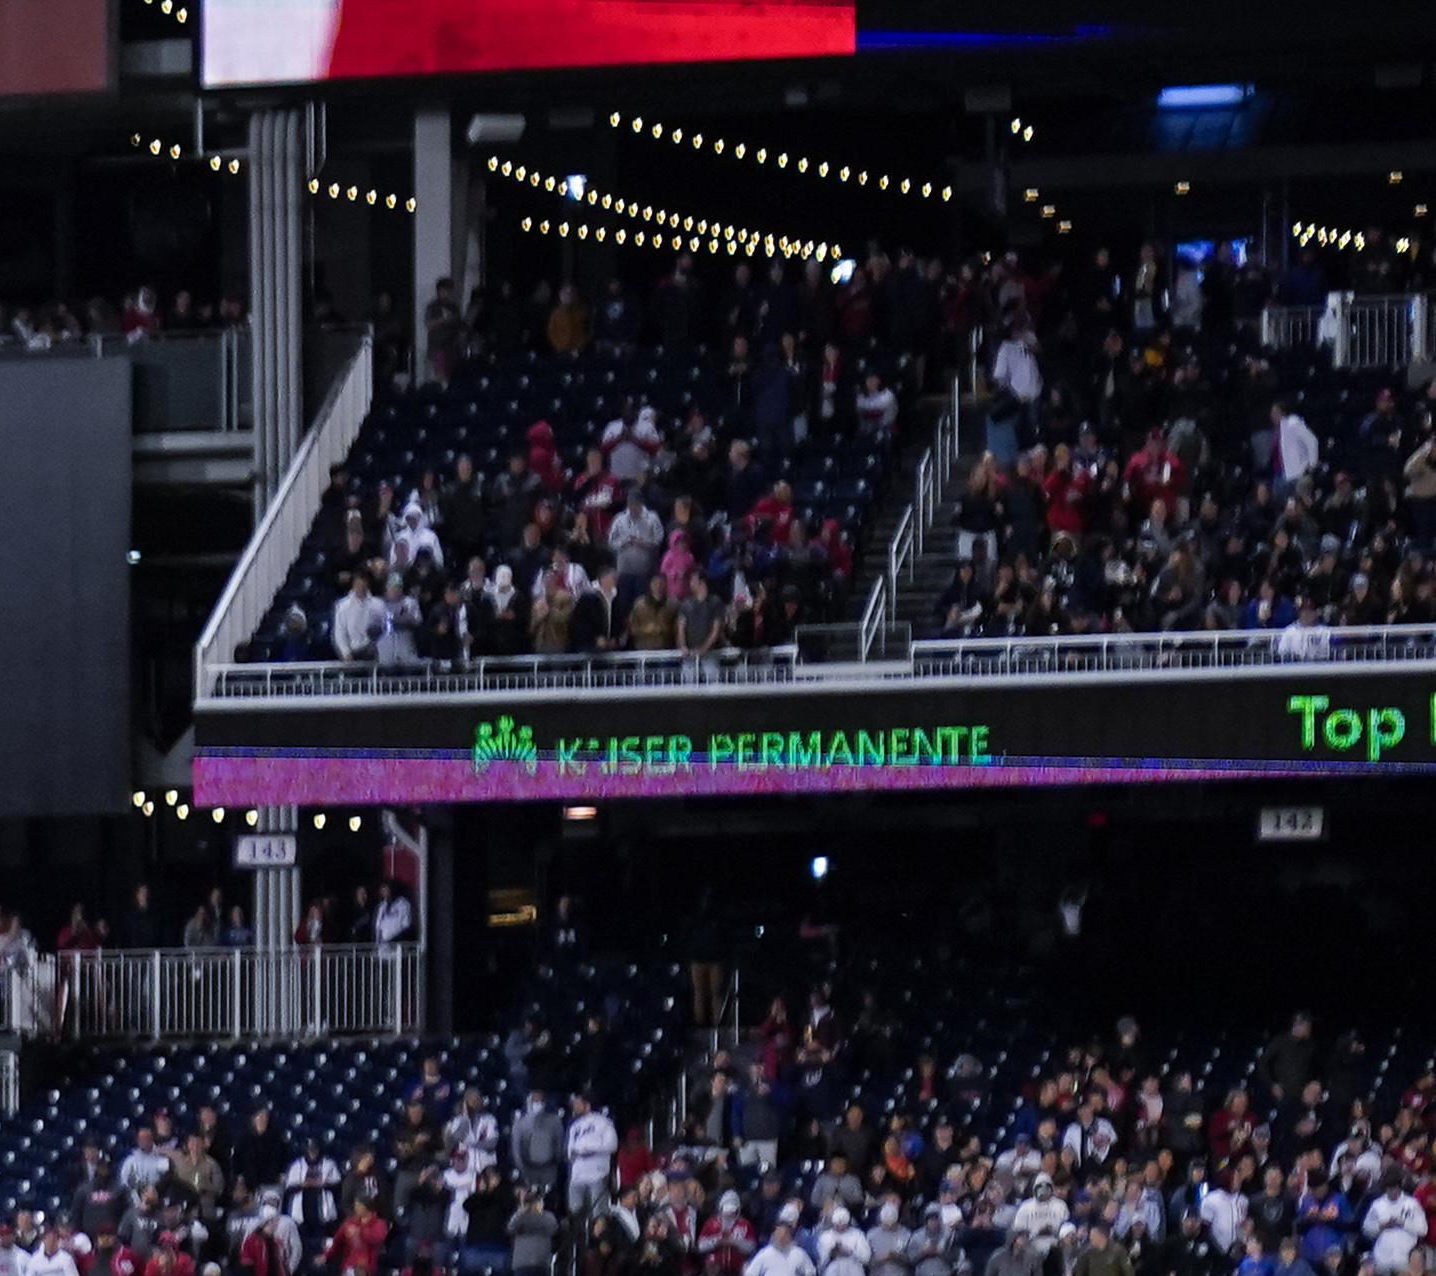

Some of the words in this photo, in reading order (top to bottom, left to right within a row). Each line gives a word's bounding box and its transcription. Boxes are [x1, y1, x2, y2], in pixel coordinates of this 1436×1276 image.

[557, 734, 692, 775] KISER
[706, 724, 994, 774] PERMANENTE
[1287, 694, 1406, 763] Top
